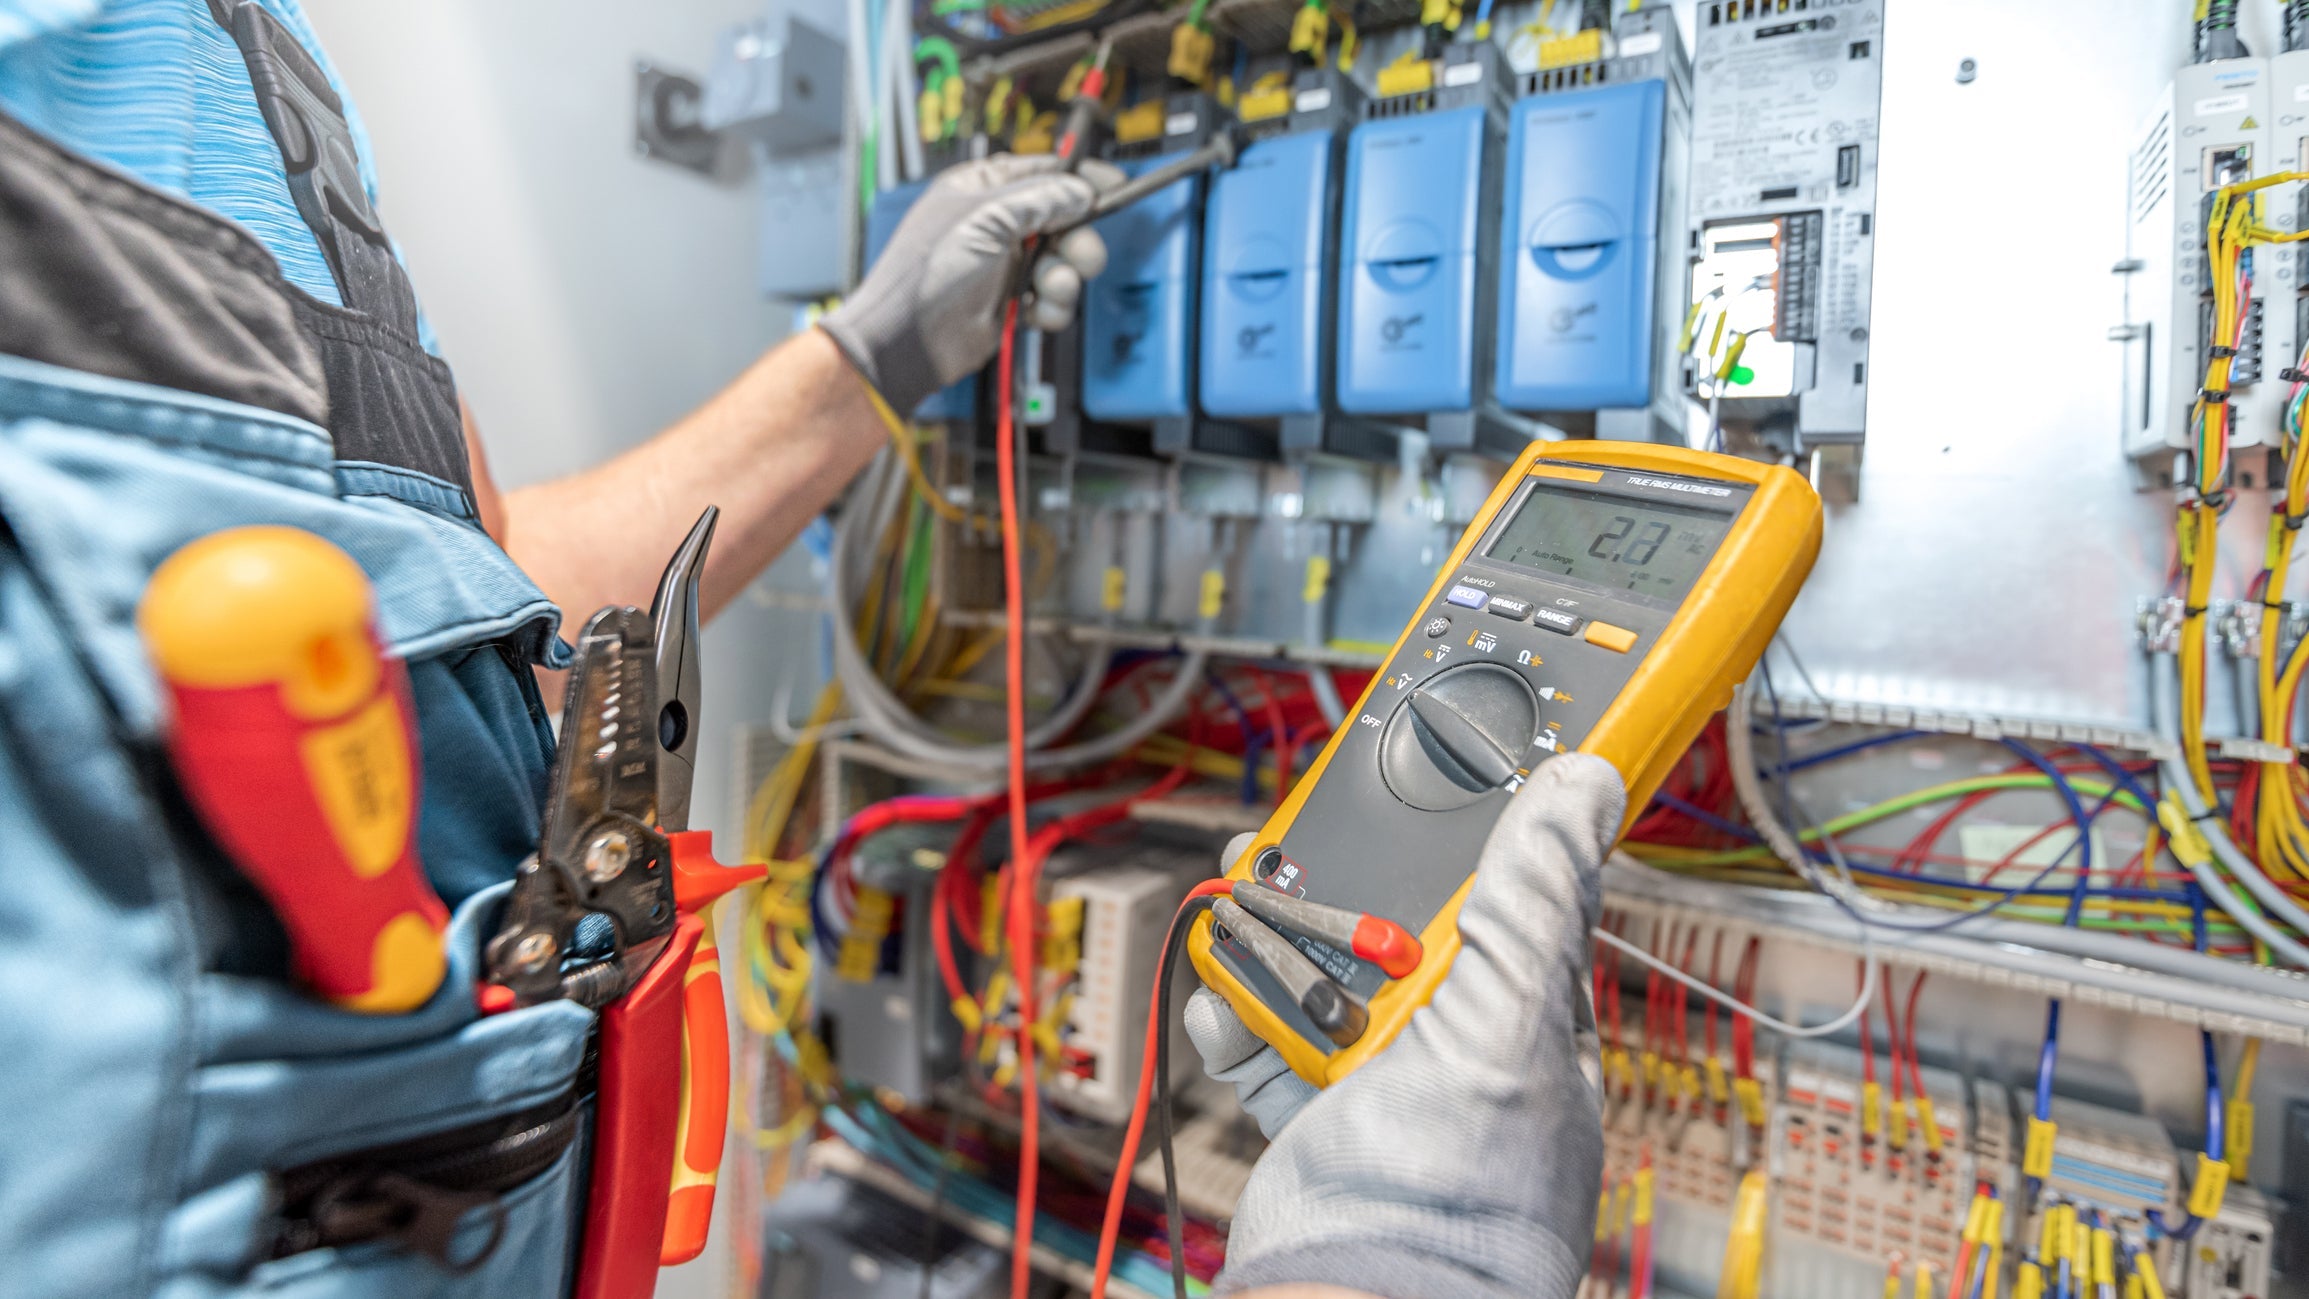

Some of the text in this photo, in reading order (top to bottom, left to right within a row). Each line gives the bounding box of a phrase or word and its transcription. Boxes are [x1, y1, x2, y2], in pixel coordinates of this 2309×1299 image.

[1627, 476, 1652, 486] TRUE
[1669, 484, 1732, 497] MULTIMETER
[1532, 549, 1575, 565] Auto Range
[1461, 575, 1496, 588] AutoHOLD
[1453, 587, 1475, 600] HOLD
[1537, 609, 1574, 627] RANGE
[1361, 713, 1382, 729] OFF
[1282, 863, 1299, 879] 400
[1275, 874, 1291, 891] mA
[1304, 944, 1328, 965] 1000V
[1325, 960, 1345, 979] CAT
[1332, 950, 1351, 968] CAT
